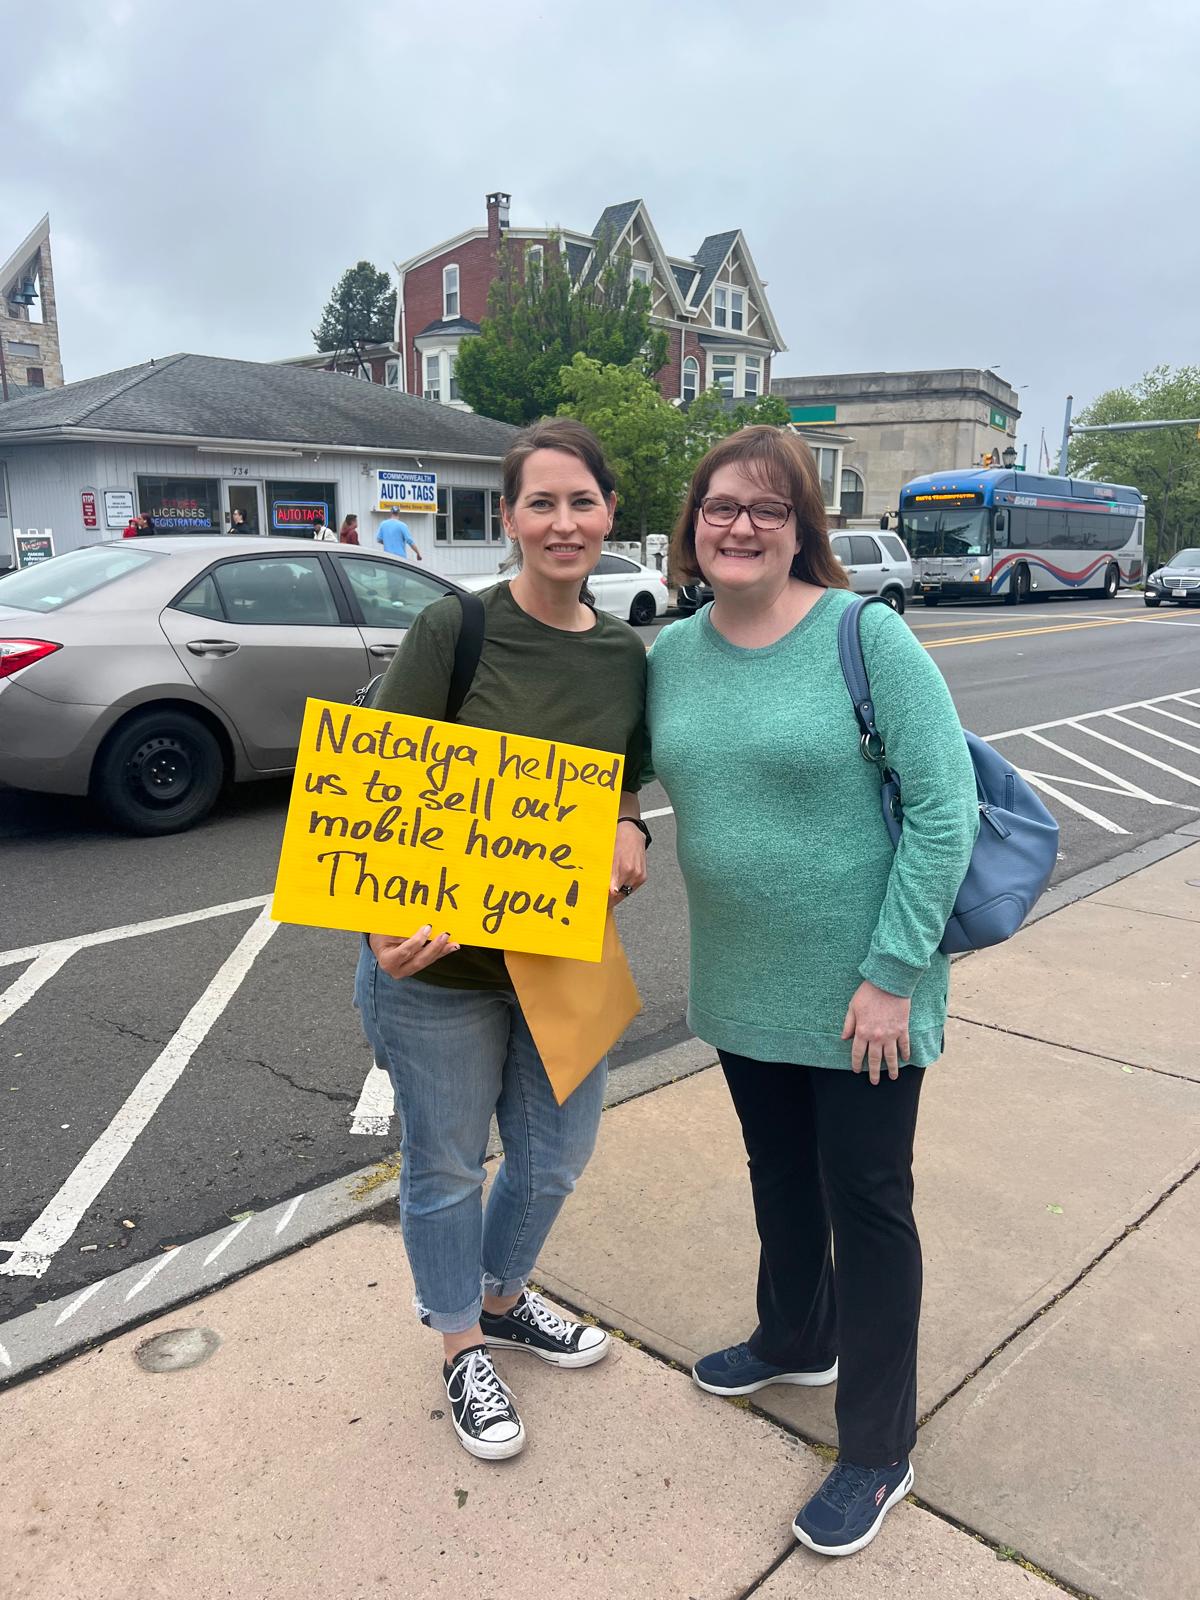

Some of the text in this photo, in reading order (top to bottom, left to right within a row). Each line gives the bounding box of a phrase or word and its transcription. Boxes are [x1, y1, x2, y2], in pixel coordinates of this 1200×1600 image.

[233, 467, 249, 476] 734
[382, 472, 432, 482] COMMONWEALTH
[381, 483, 435, 501] AUTO TAGS
[152, 508, 205, 518] LICENSES
[278, 509, 301, 521] AUTO
[315, 708, 621, 807] Natalya helped
[304, 770, 578, 822] us to sell our
[308, 806, 445, 851] mobile
[317, 850, 579, 935] Thank you!
